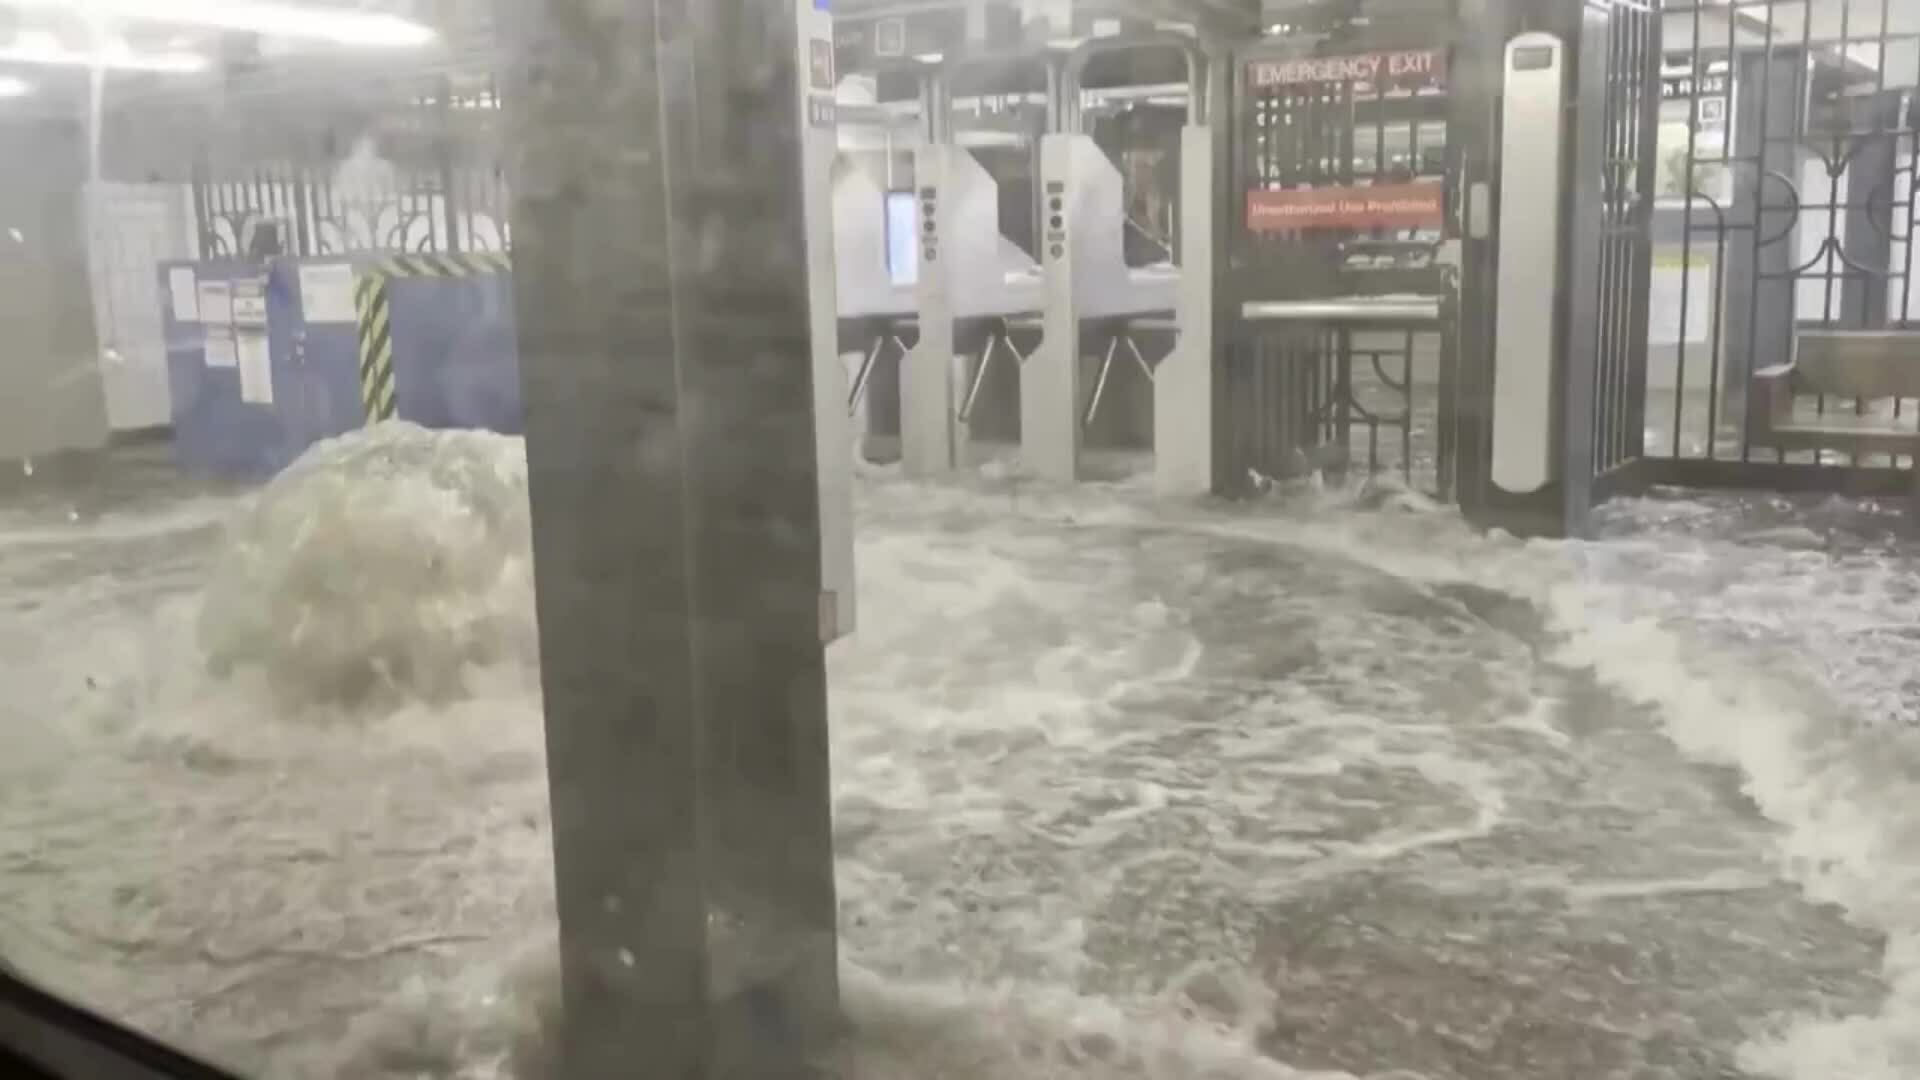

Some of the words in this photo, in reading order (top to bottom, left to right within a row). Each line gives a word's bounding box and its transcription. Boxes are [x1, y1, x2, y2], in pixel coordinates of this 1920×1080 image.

[1256, 55, 1381, 86] EMERGENCY
[1389, 51, 1432, 75] EXIT
[1252, 201, 1335, 217] Uthorid
